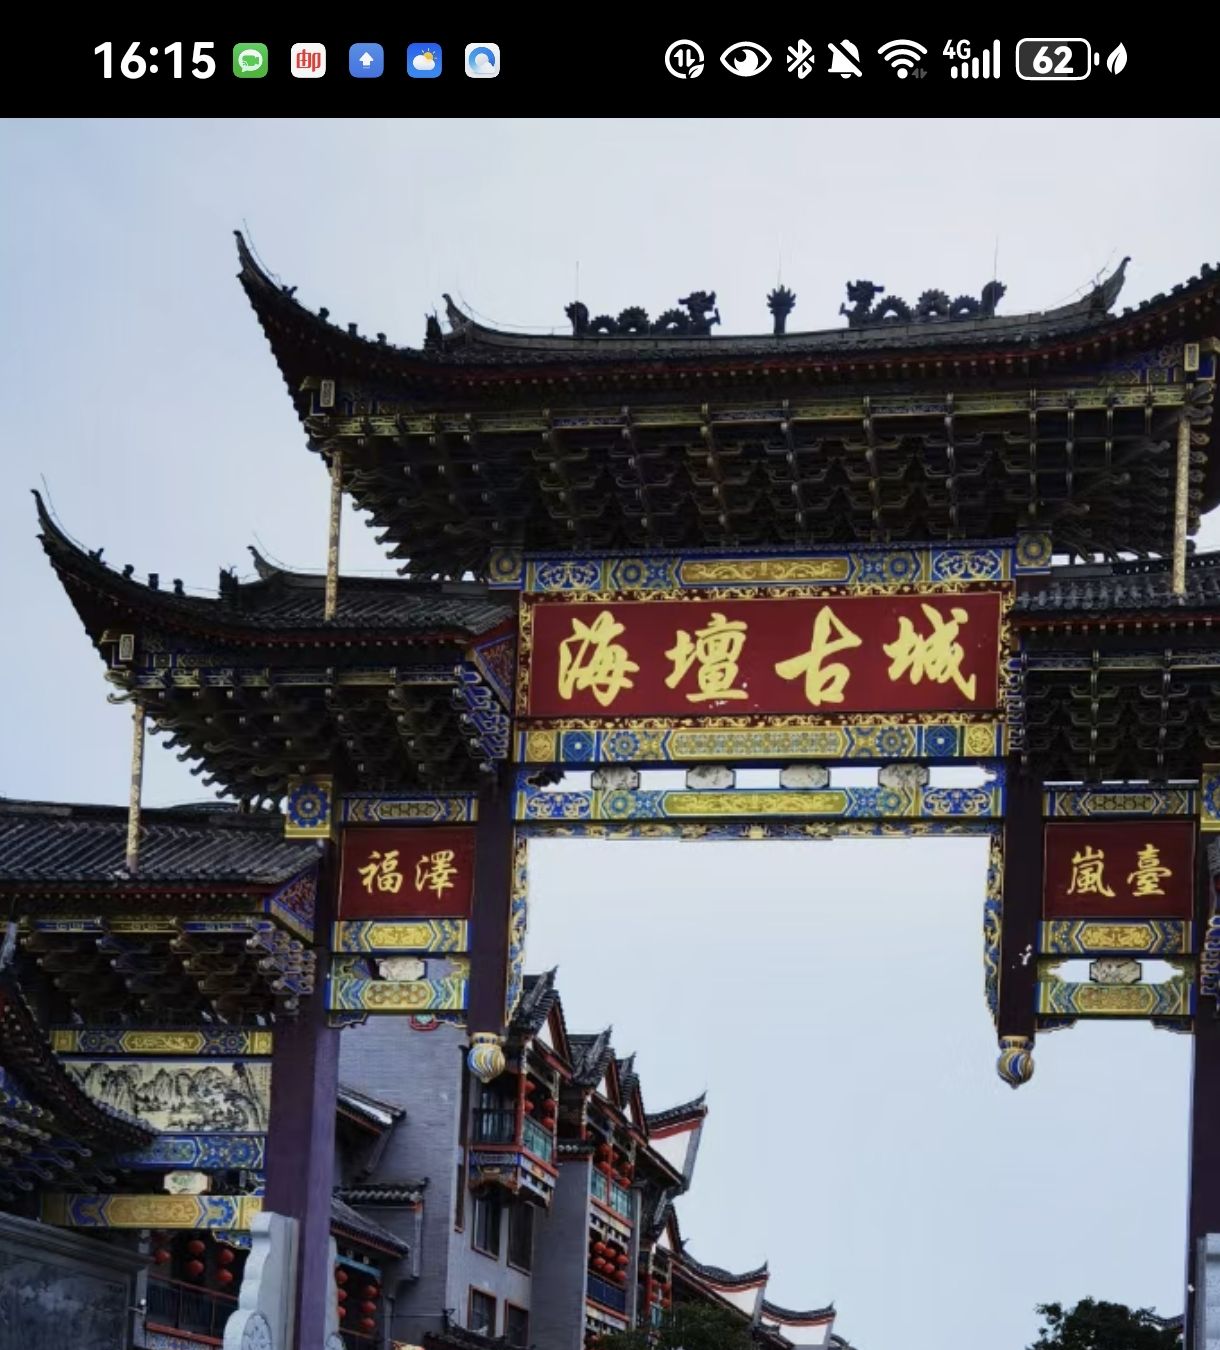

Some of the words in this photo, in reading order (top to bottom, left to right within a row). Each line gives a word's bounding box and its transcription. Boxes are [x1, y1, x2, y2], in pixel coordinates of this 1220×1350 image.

[557, 603, 977, 706] 海壇古城
[358, 850, 458, 899] 福澤
[1066, 843, 1173, 897] 嵐臺
